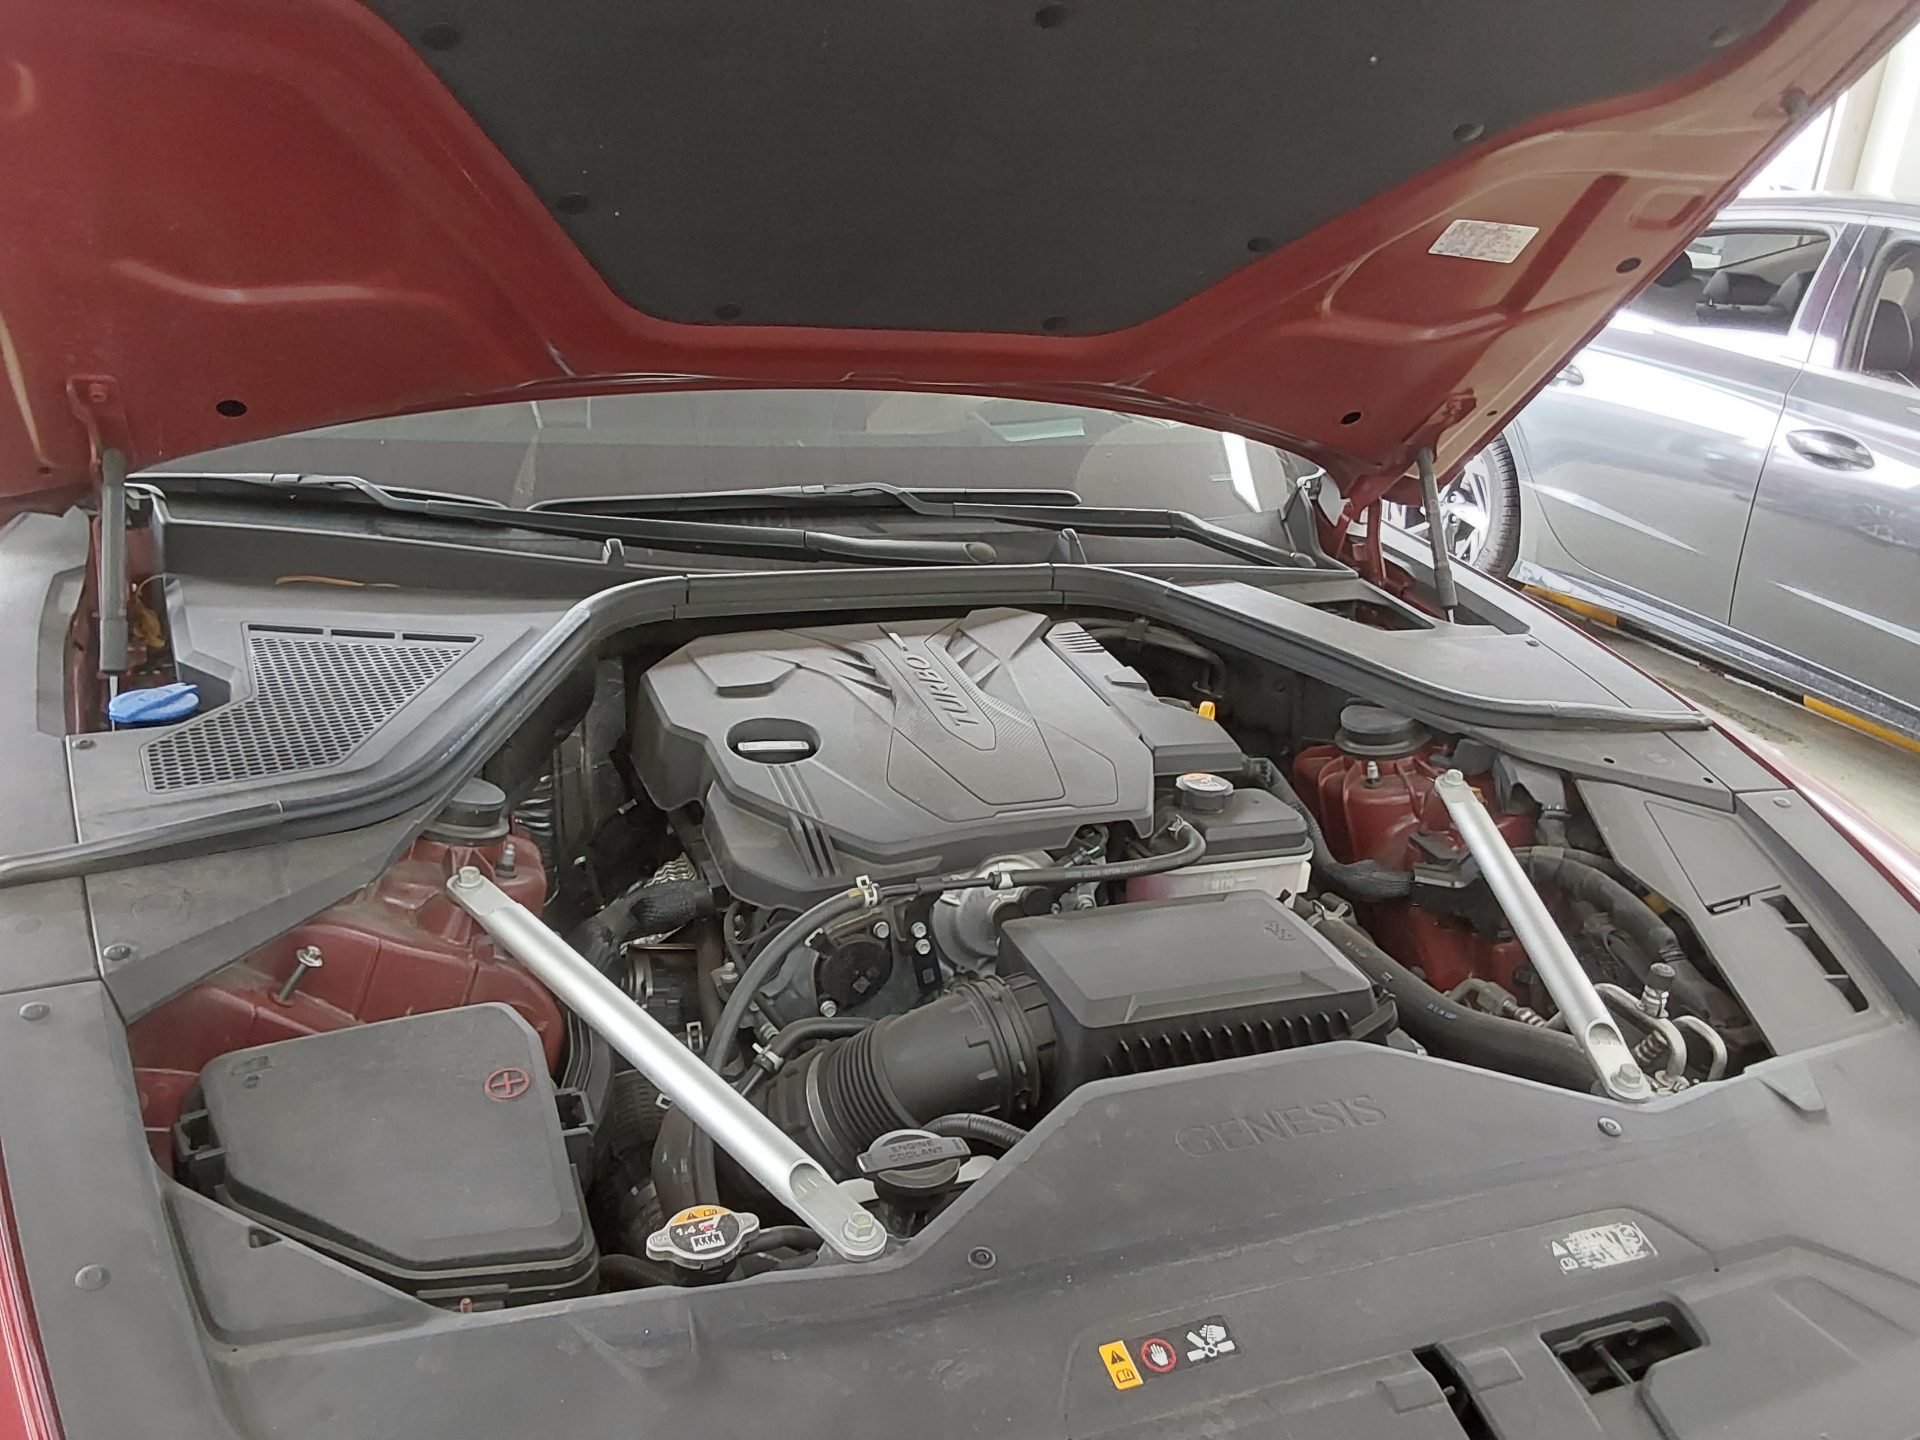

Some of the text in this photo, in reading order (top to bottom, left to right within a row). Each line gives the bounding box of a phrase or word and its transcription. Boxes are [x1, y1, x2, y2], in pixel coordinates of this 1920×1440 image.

[904, 655, 980, 727] TURBO
[1174, 1094, 1387, 1158] GENESIS
[888, 1146, 944, 1162] COOLANT
[890, 1140, 935, 1153] ENGINE
[675, 1225, 697, 1237] 1.4
